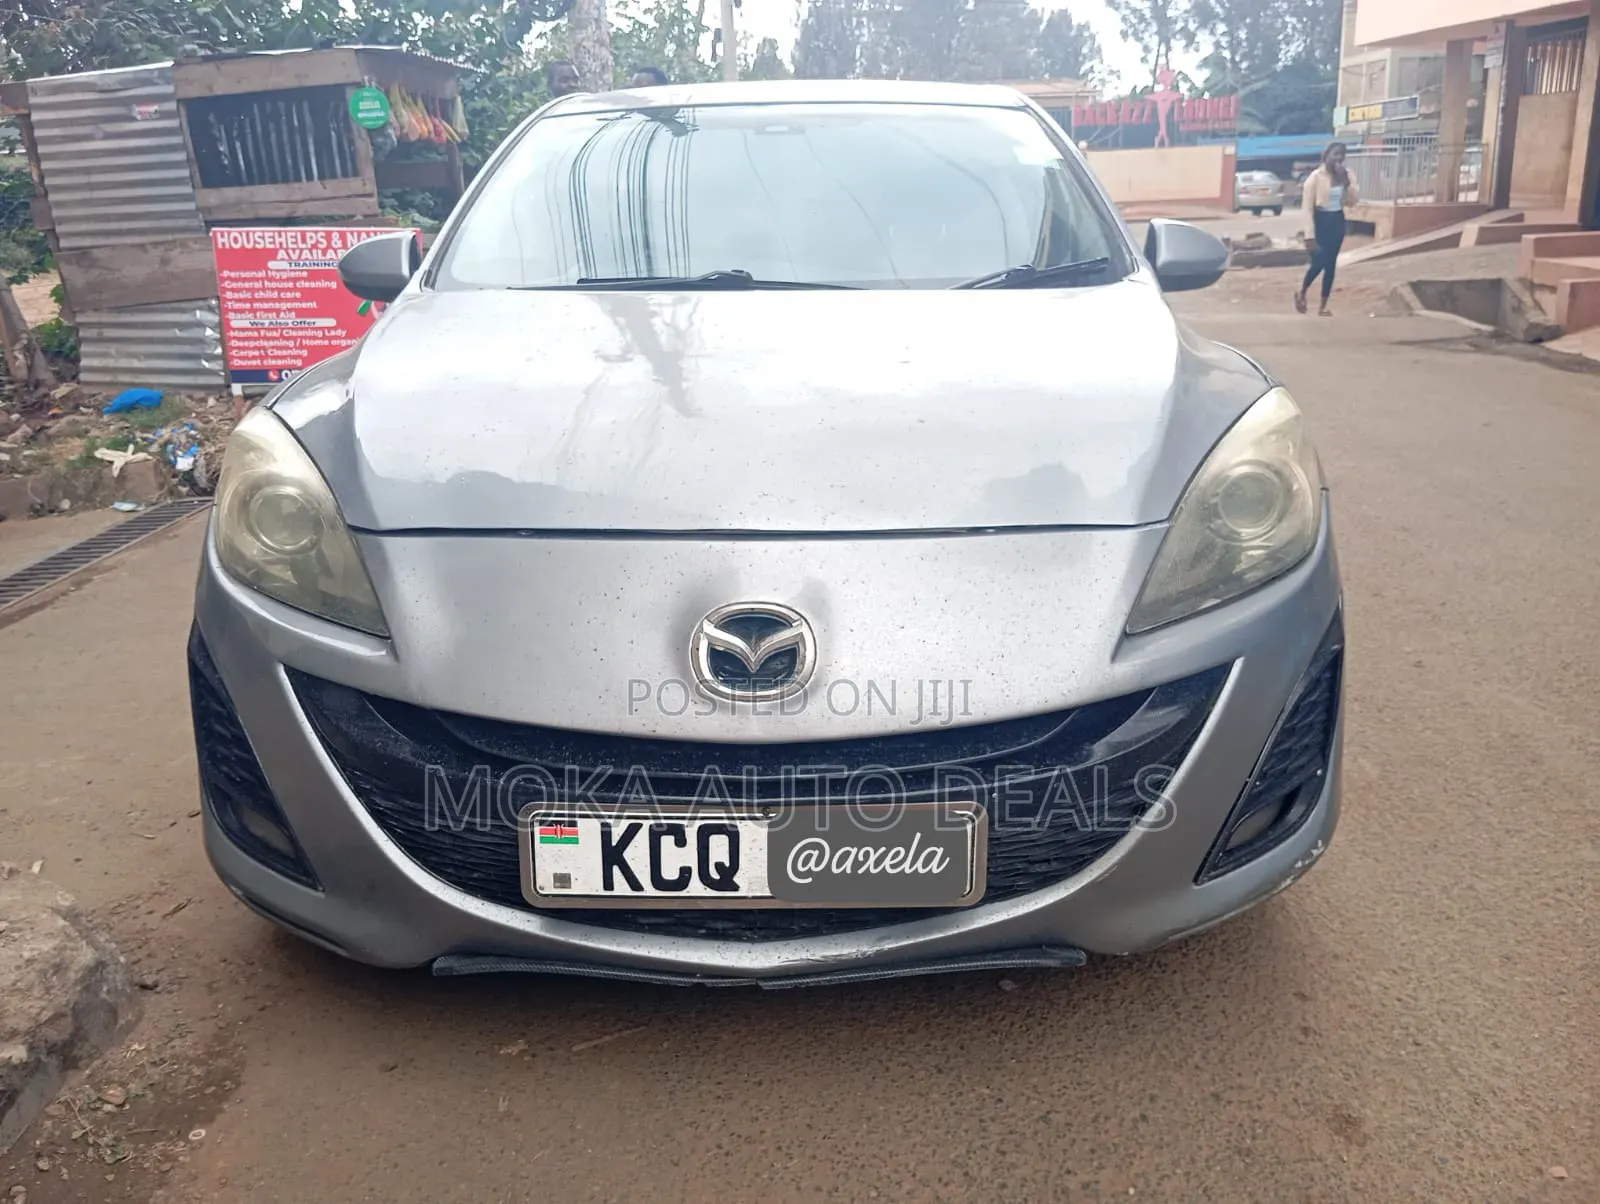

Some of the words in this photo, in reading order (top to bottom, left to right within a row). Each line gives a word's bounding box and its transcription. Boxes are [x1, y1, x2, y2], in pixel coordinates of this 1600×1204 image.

[217, 231, 327, 249] HOUSEHELPS
[331, 231, 343, 249] &
[268, 270, 308, 279] Hygiene
[264, 280, 295, 289] house
[296, 280, 337, 290] cleaning
[254, 290, 278, 299] child
[280, 291, 302, 299] care
[253, 301, 317, 311] management
[256, 311, 277, 320] first
[279, 311, 296, 320] Aid
[249, 320, 266, 328] We
[268, 320, 290, 328] Also
[291, 320, 317, 328] Offer
[283, 329, 323, 338] Cleaning
[324, 329, 348, 338] Lady
[302, 339, 331, 347] Home
[267, 348, 309, 358] Cleaning
[263, 357, 303, 367] cleaning
[600, 822, 740, 893] KCQ
